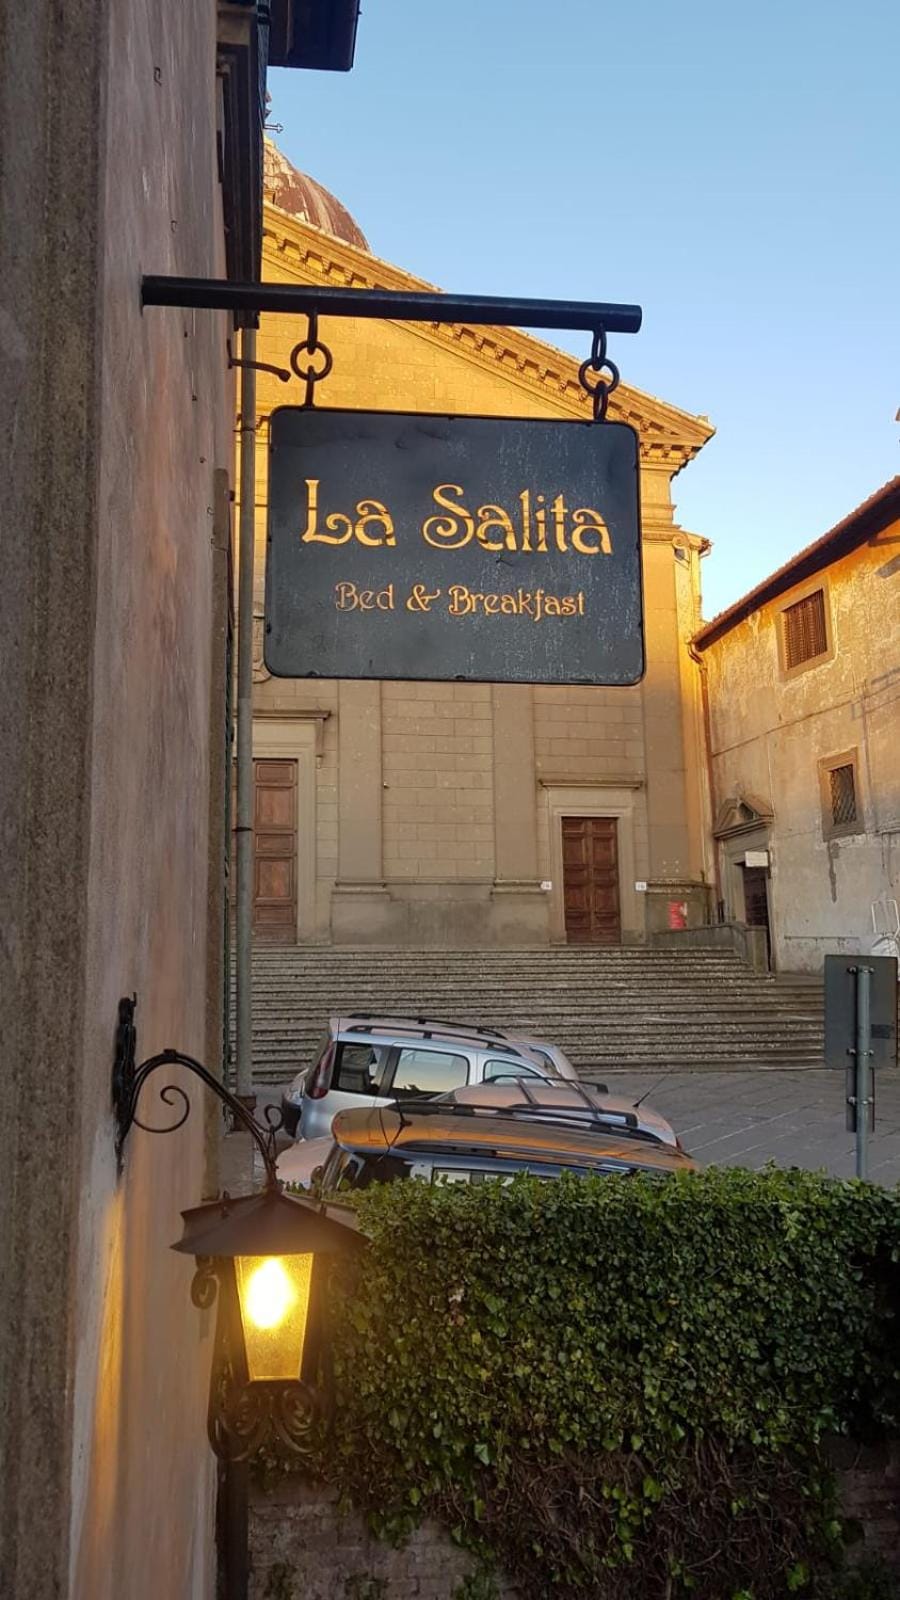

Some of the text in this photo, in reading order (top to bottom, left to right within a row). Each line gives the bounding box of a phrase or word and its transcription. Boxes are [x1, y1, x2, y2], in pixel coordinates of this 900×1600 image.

[302, 479, 613, 555] La Salita
[335, 581, 585, 622] Bed & Breakfast
